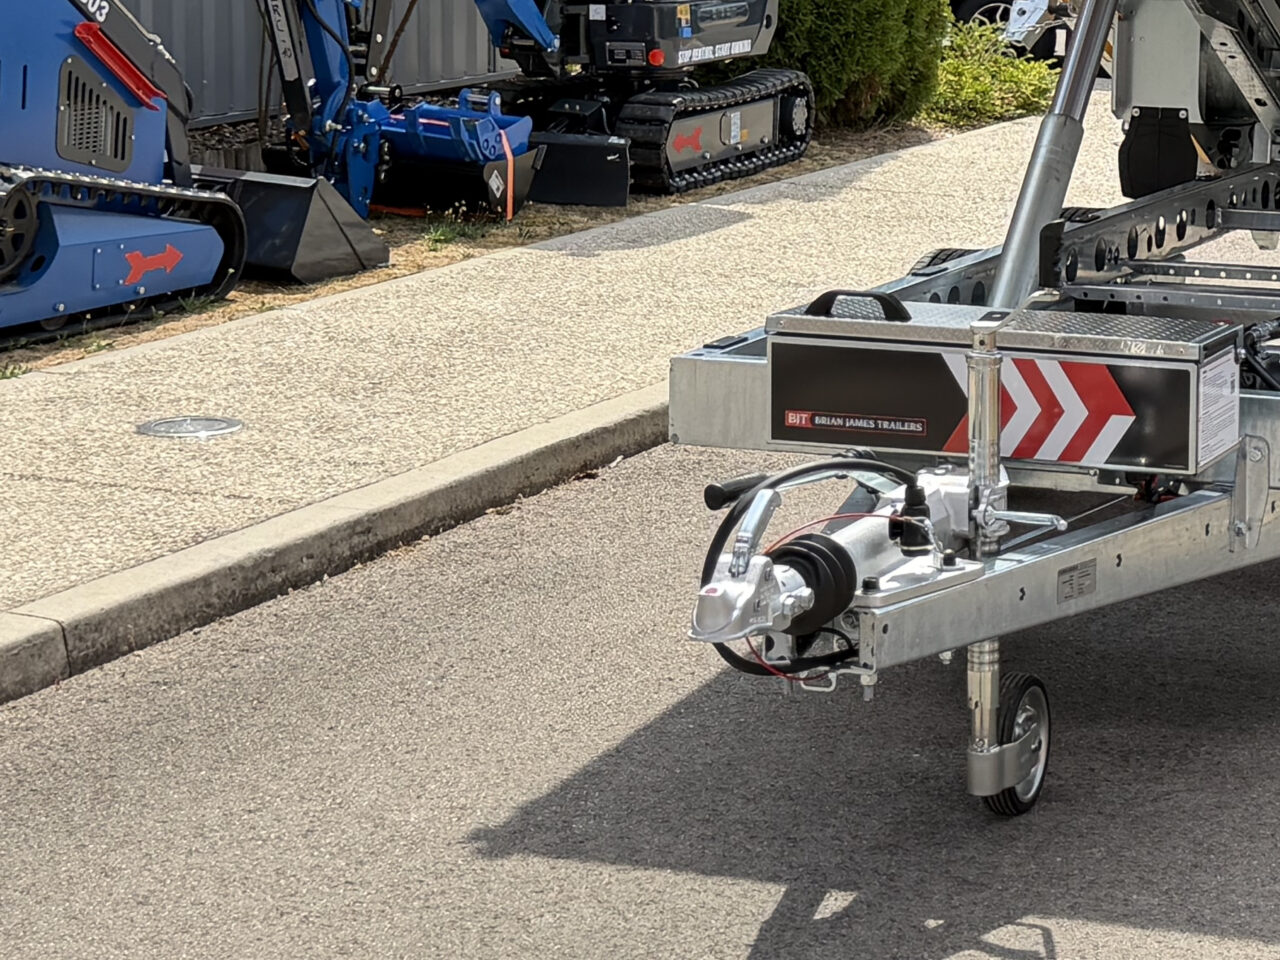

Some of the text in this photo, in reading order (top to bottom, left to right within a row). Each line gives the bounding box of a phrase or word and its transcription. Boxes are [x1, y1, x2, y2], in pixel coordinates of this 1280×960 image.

[814, 415, 843, 426] BRIAN
[845, 418, 875, 429] JAMES
[877, 420, 923, 432] TRAILERS
